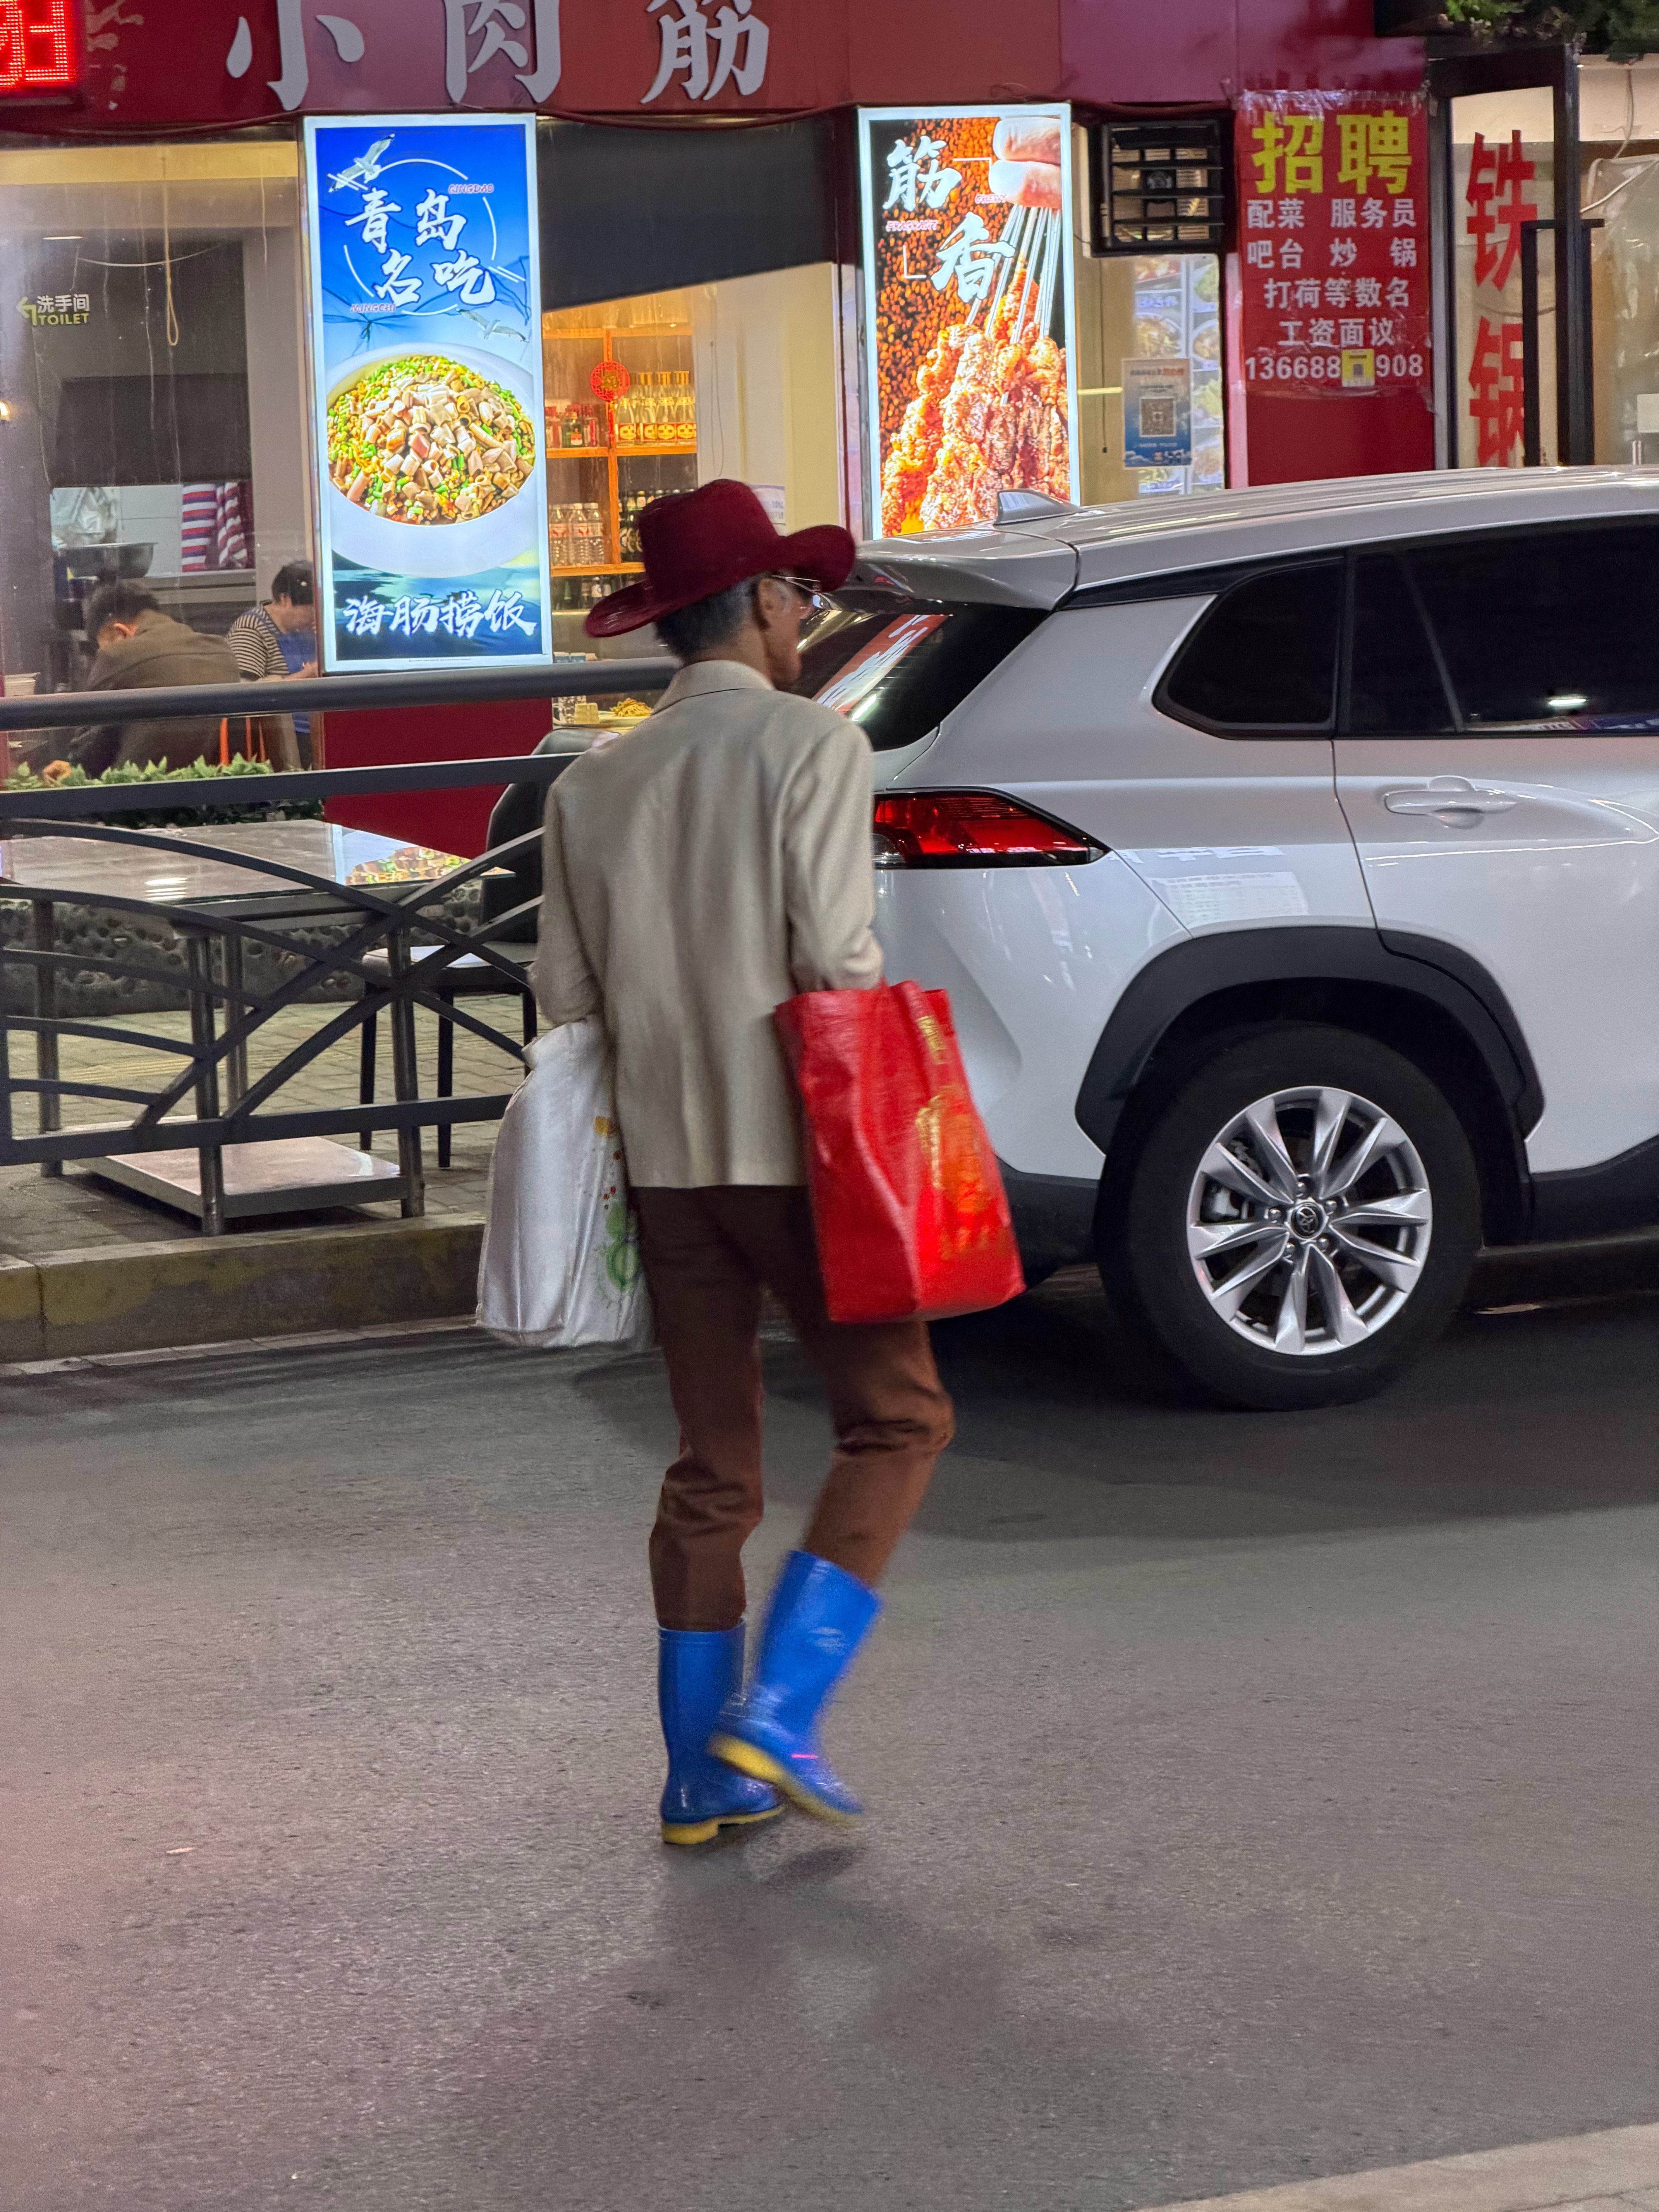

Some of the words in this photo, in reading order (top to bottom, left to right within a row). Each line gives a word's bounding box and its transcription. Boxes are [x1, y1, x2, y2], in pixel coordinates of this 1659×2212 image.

[1252, 111, 1412, 195] 招聘
[448, 184, 494, 194] QINGDAO
[882, 136, 962, 212] 筋
[345, 187, 467, 254] 青岛
[1247, 198, 1305, 228] 配菜
[1330, 198, 1417, 228] 服务员
[931, 211, 1015, 303] 香
[1247, 238, 1304, 269] 吧台
[372, 248, 496, 306] 名吃
[1264, 276, 1410, 308] 打荷等数名
[37, 294, 90, 313] 洗手间
[350, 303, 397, 313] MINGCHI
[39, 313, 90, 326] TOILET
[1277, 317, 1394, 347] 工资面议
[1245, 354, 1424, 380] 136688908
[343, 589, 538, 638] 海肠捞饭
